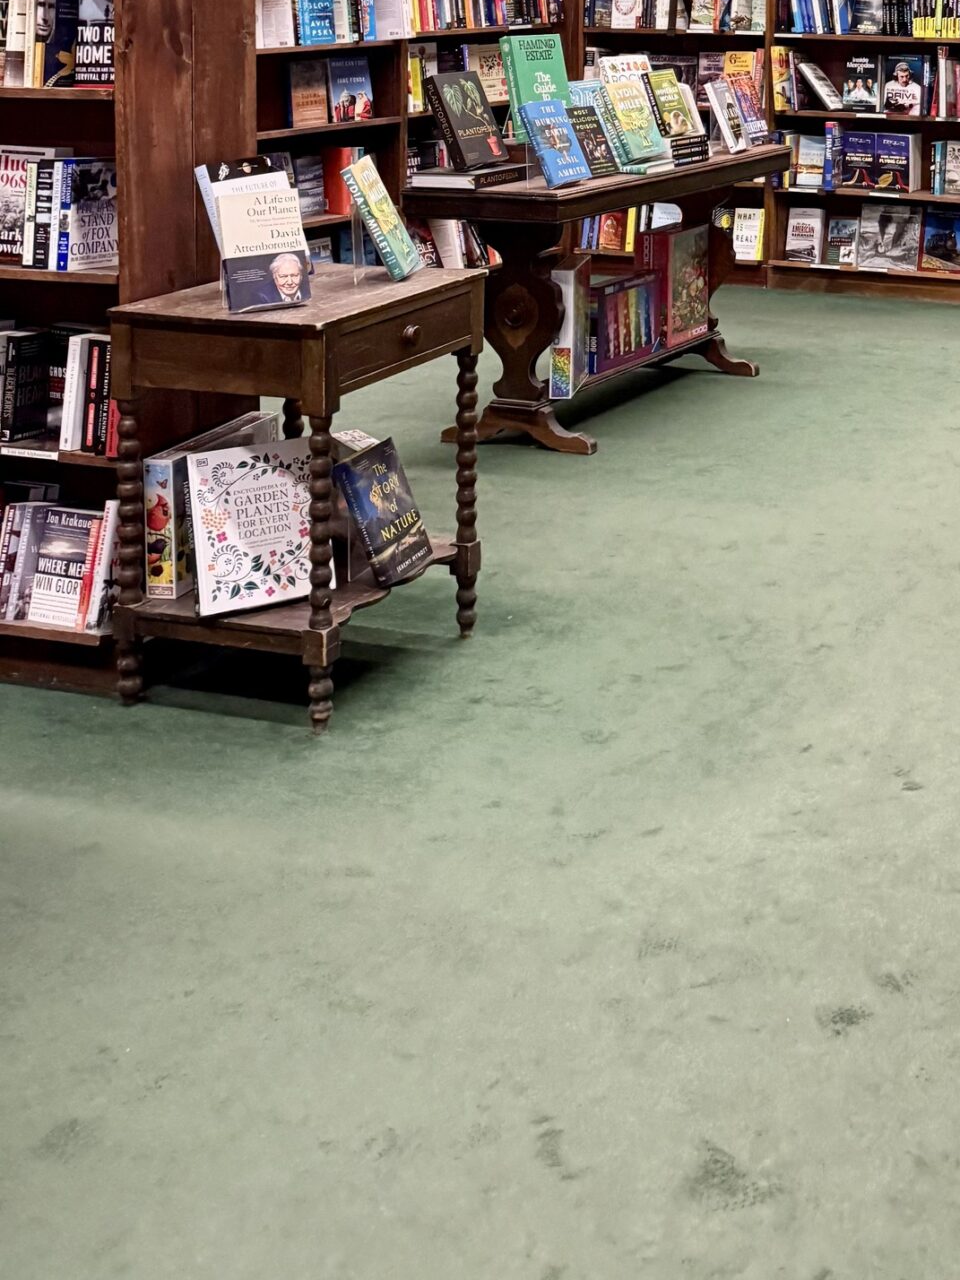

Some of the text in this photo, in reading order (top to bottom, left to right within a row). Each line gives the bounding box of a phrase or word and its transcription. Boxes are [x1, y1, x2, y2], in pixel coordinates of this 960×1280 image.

[78, 26, 100, 42] TWO
[76, 46, 112, 64] HOME
[526, 50, 553, 62] ESTATE
[458, 125, 497, 137] PLANTOPEDIA
[480, 171, 519, 184] PLANTOPEDIA
[342, 173, 363, 205] LYDIA
[254, 197, 263, 206] A
[264, 195, 283, 205] Life
[246, 204, 298, 217] Our Planet
[80, 214, 114, 227] STAND
[92, 228, 110, 239] FOX
[270, 227, 301, 239] David
[71, 240, 119, 255] COMPANY
[233, 238, 302, 254] Attenborough
[234, 488, 290, 507] GARDEN
[236, 502, 290, 518] PLANTS
[237, 512, 290, 530] FOR EVERY
[380, 508, 420, 542] NATURE
[238, 523, 292, 540] LOCATION
[38, 557, 67, 575] WHERE
[35, 575, 52, 591] WIN
